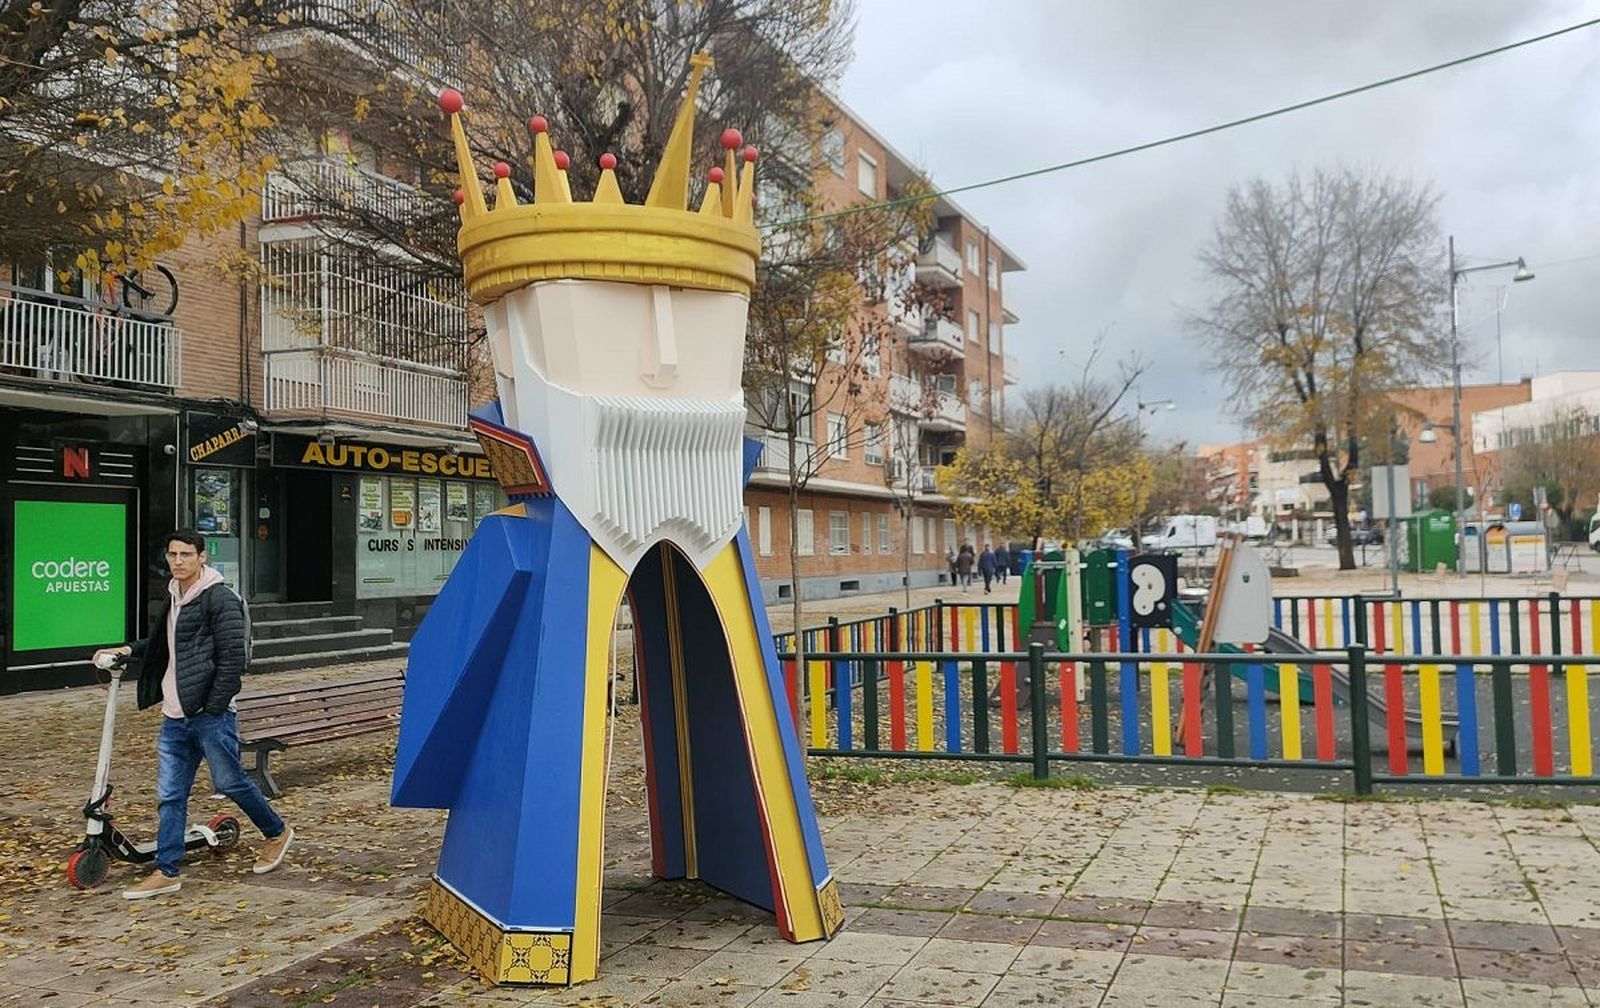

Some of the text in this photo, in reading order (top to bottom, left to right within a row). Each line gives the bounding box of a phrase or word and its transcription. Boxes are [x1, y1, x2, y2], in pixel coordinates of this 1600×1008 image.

[63, 447, 90, 479] N
[301, 441, 497, 478] AUTO-ESCUE
[31, 556, 110, 579] codere
[46, 580, 110, 593] APUESTAS
